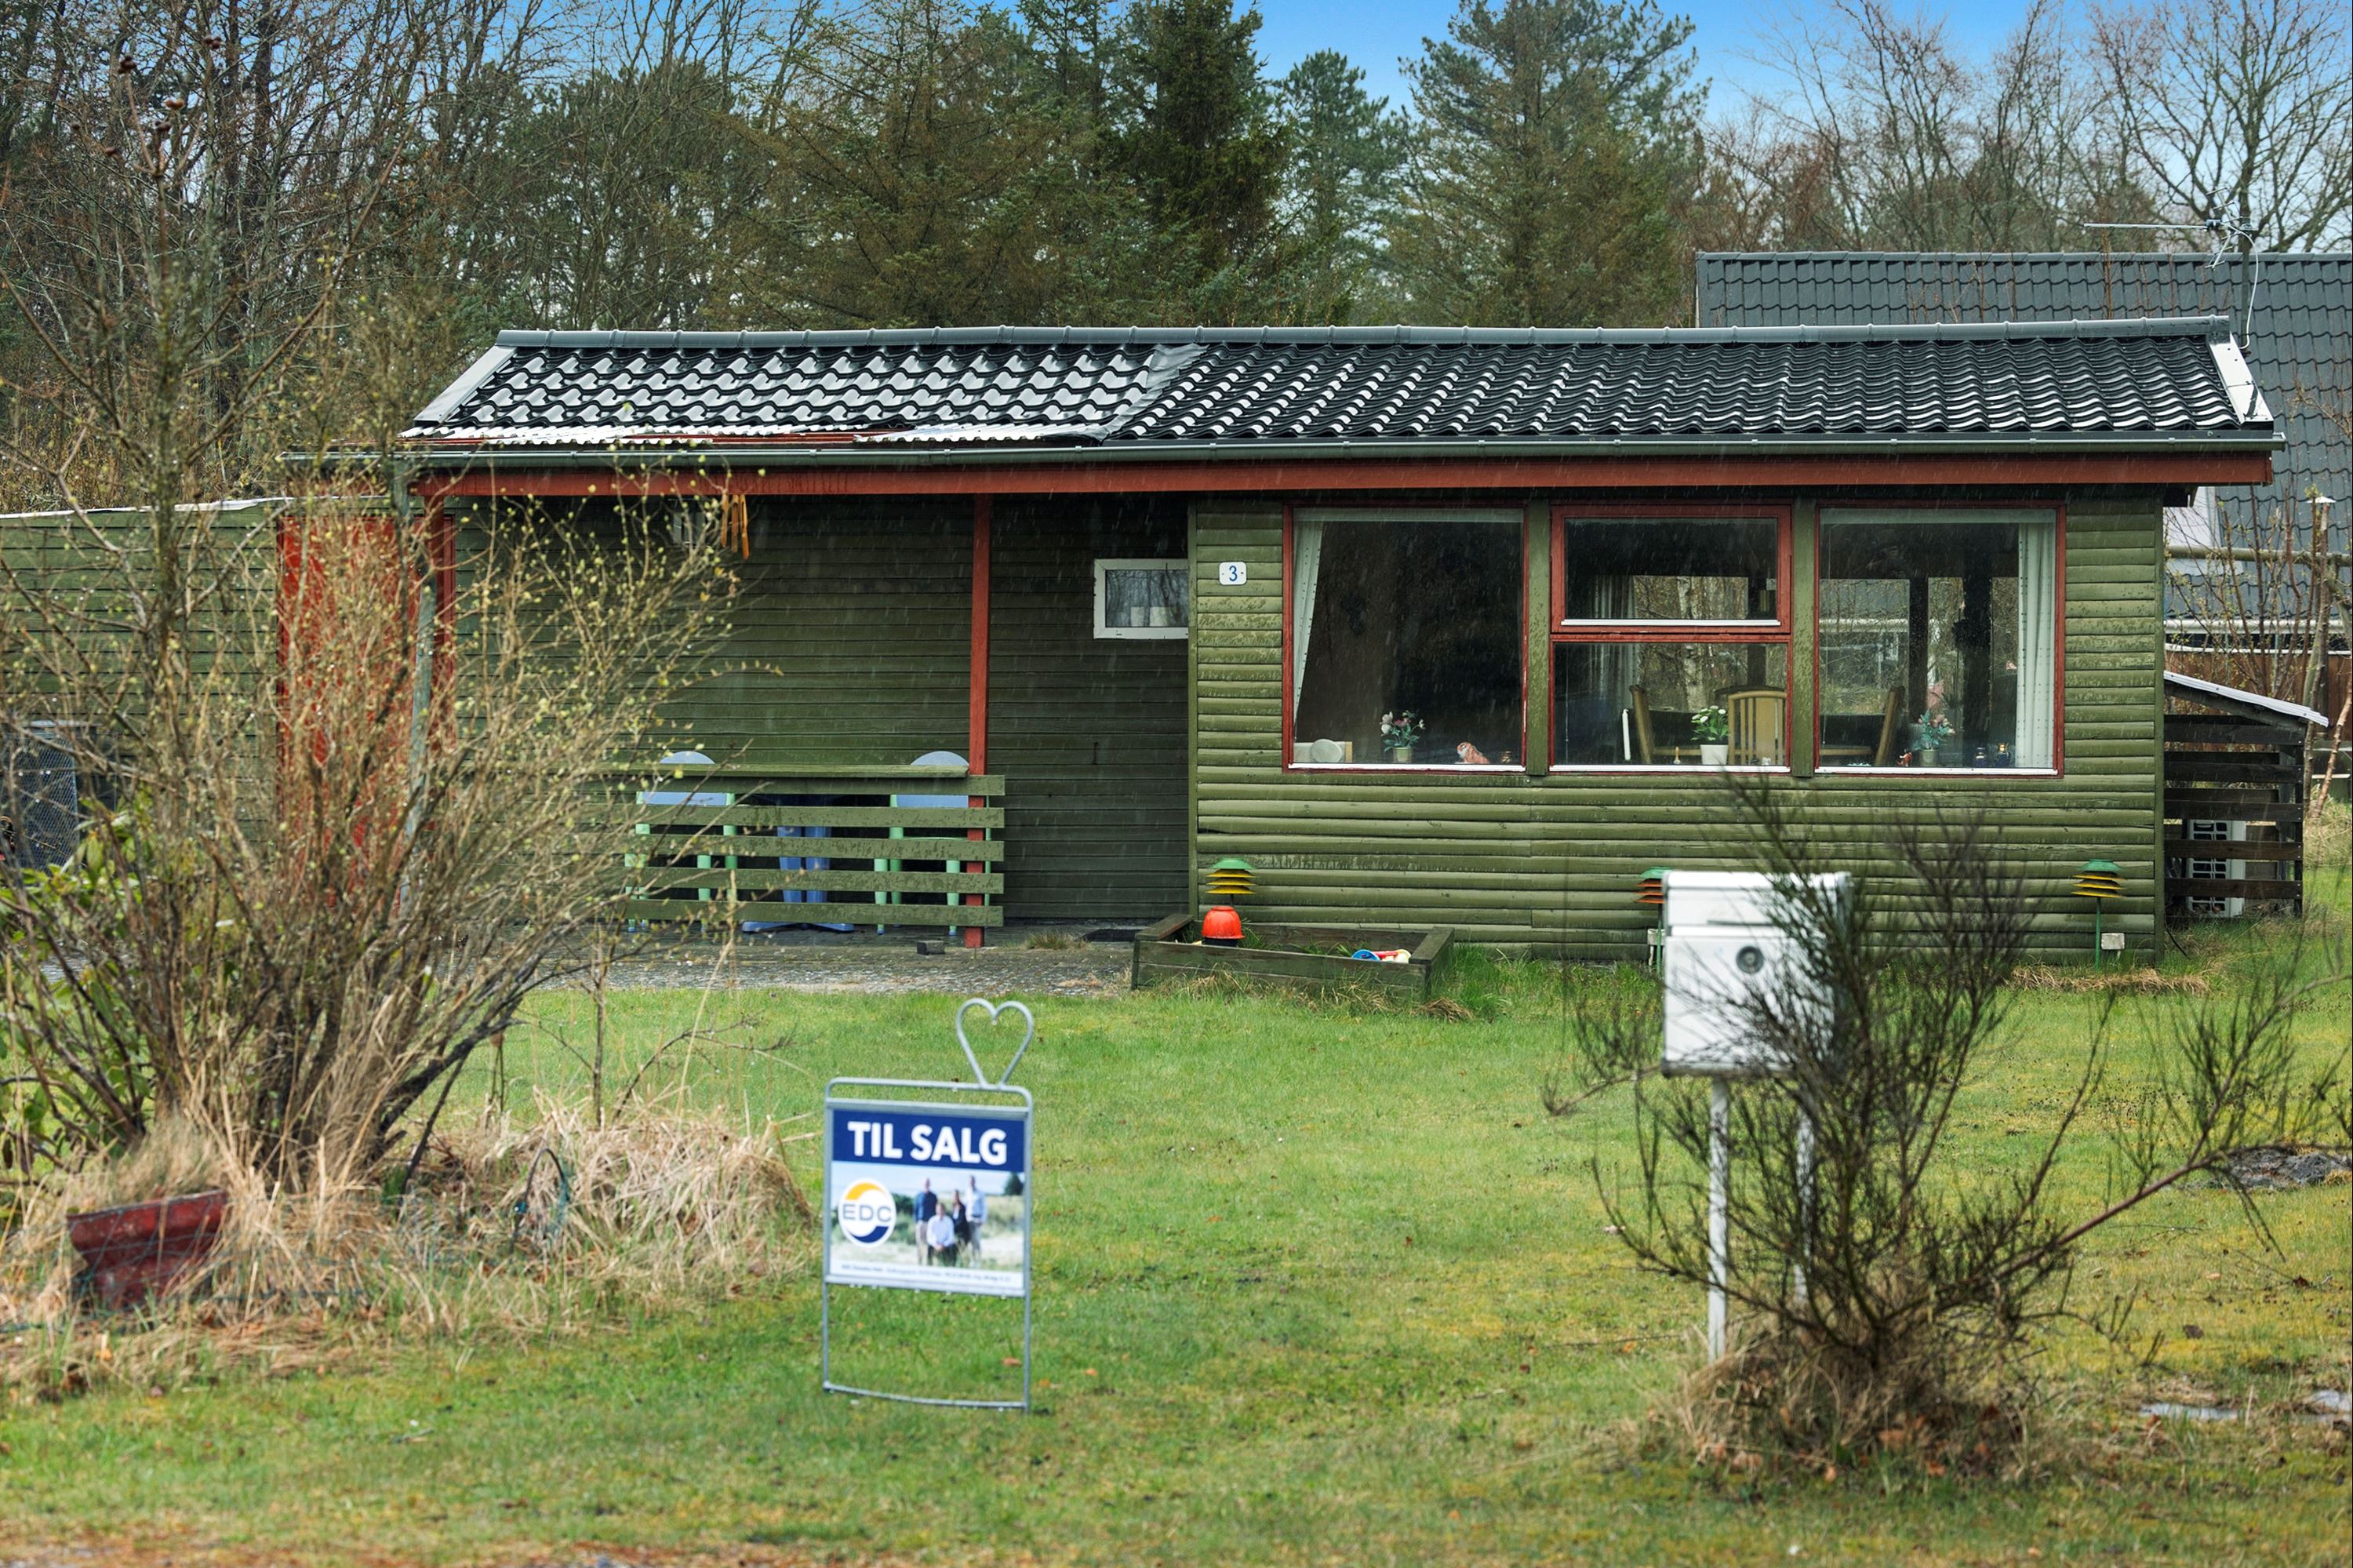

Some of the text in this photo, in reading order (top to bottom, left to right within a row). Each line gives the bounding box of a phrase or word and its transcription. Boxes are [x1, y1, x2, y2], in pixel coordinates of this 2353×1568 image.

[1229, 566, 1238, 582] 3
[847, 1121, 1008, 1166] TIL SALG
[842, 1204, 893, 1222] EDC
